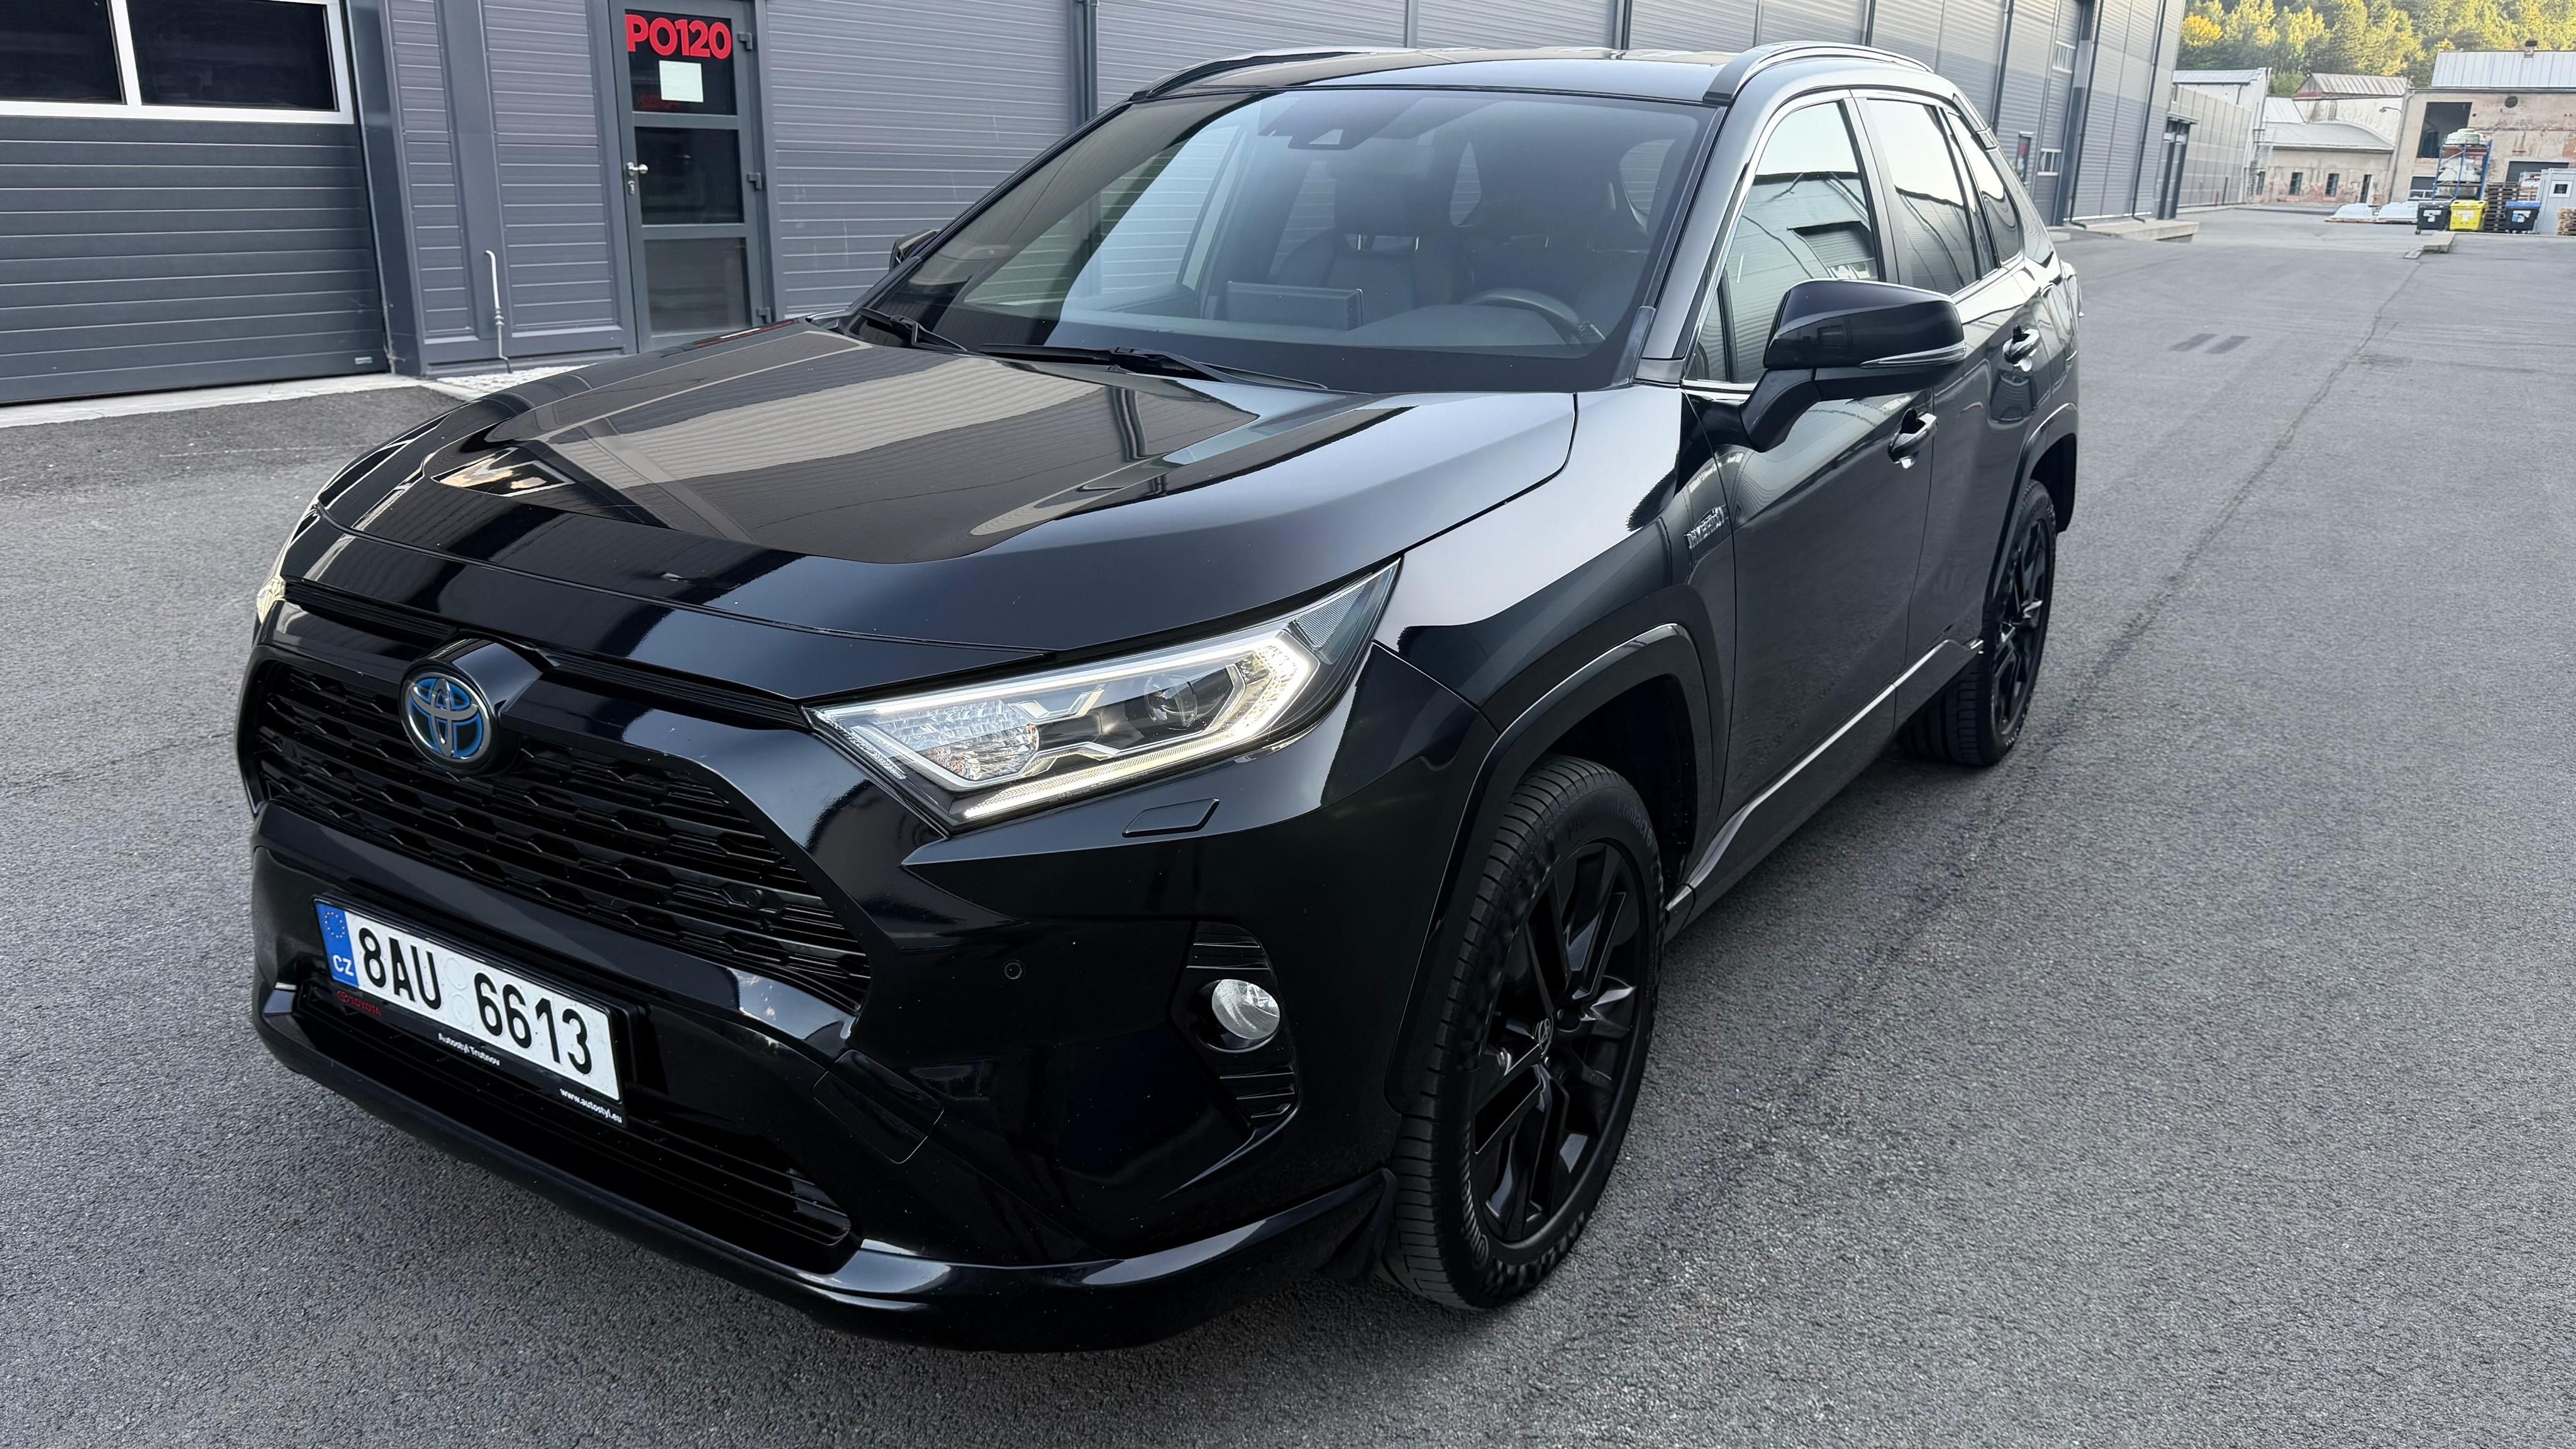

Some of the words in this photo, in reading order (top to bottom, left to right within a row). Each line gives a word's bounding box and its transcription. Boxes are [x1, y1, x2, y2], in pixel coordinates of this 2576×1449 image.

[625, 14, 732, 59] PO120
[333, 954, 354, 977] CZ
[349, 996, 382, 1016] TOYOTA
[359, 927, 441, 1010] 8AU
[474, 973, 592, 1074] 6613
[560, 1088, 622, 1123] www.autostyl.eu
